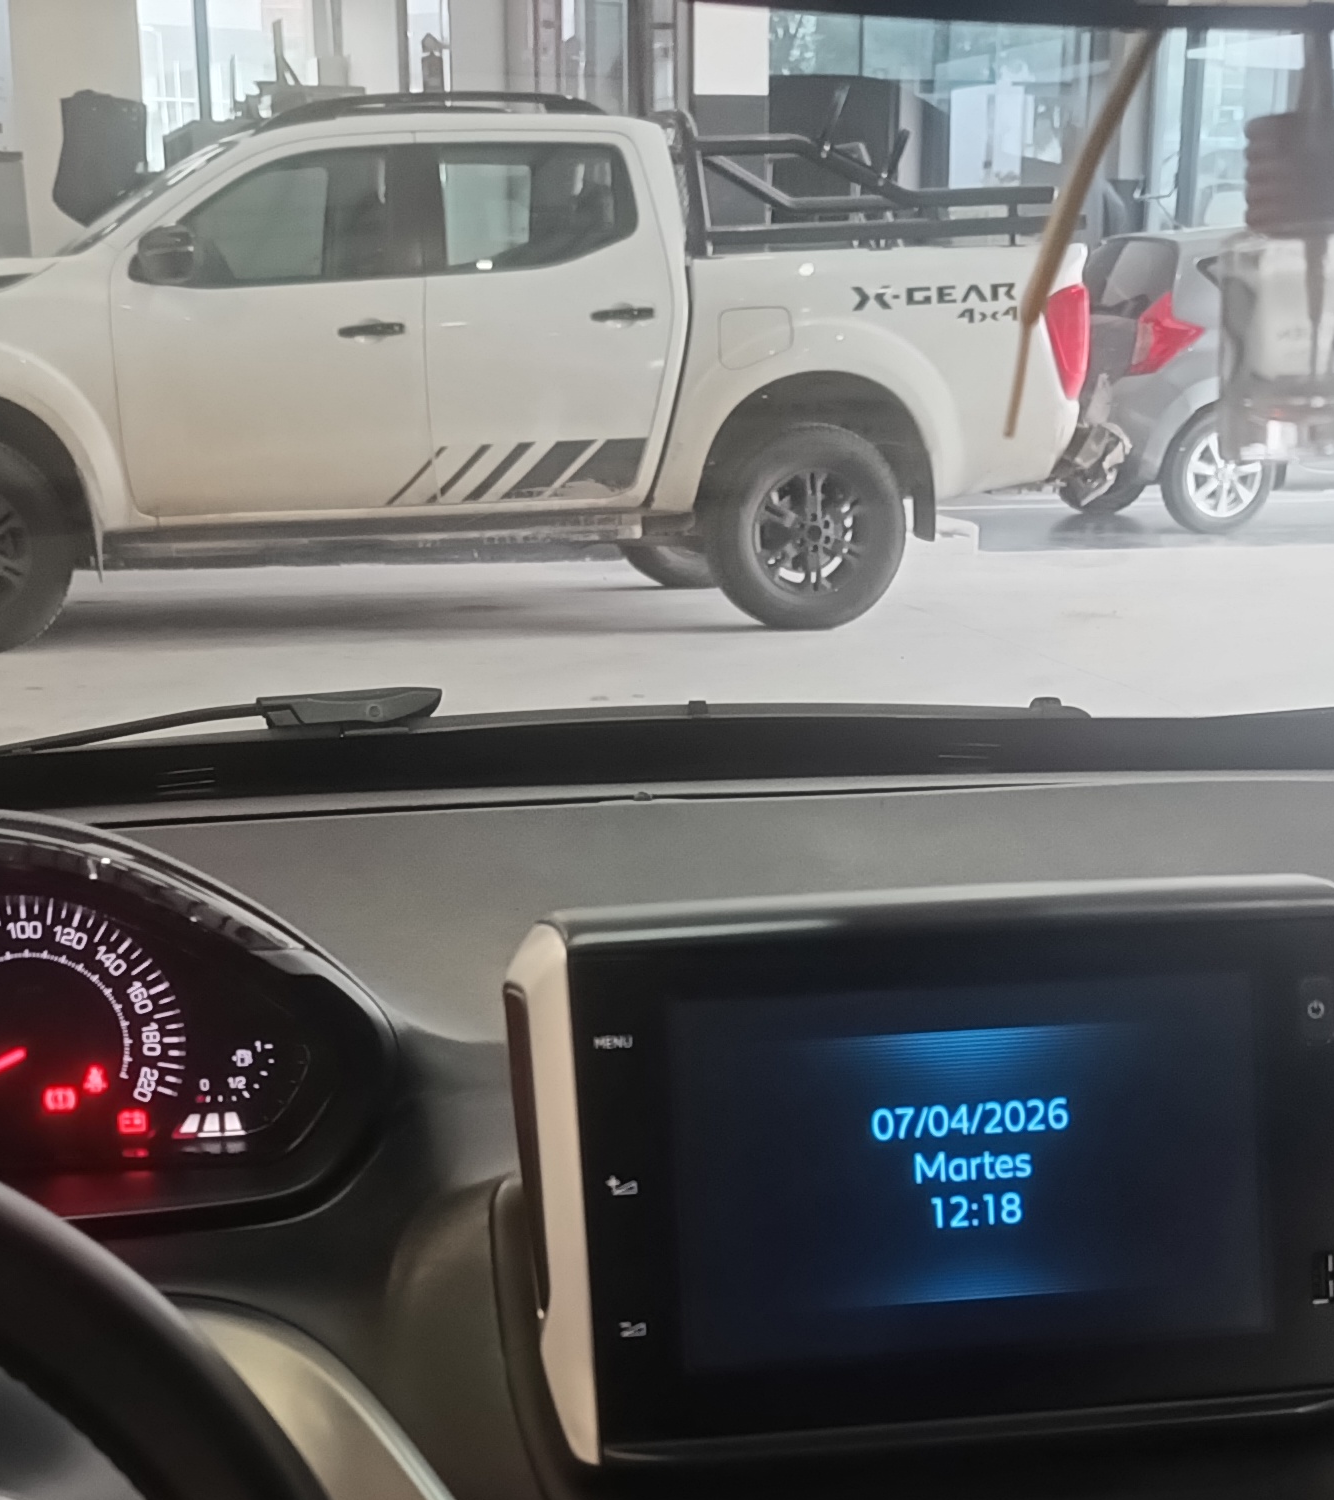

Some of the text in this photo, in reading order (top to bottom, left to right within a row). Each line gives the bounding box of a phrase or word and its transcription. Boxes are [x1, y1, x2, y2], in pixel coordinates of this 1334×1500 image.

[851, 282, 1016, 312] X-GEAR
[6, 920, 43, 940] 100
[53, 924, 89, 950] 120
[95, 945, 128, 977] 140
[126, 980, 154, 1015] 160
[141, 1021, 162, 1057] 180
[593, 1033, 633, 1049] MENU
[132, 1066, 159, 1103] 220
[870, 1096, 1070, 1142] 07/04/2026
[913, 1150, 1033, 1185] Martes
[930, 1191, 1023, 1229] 12:18
